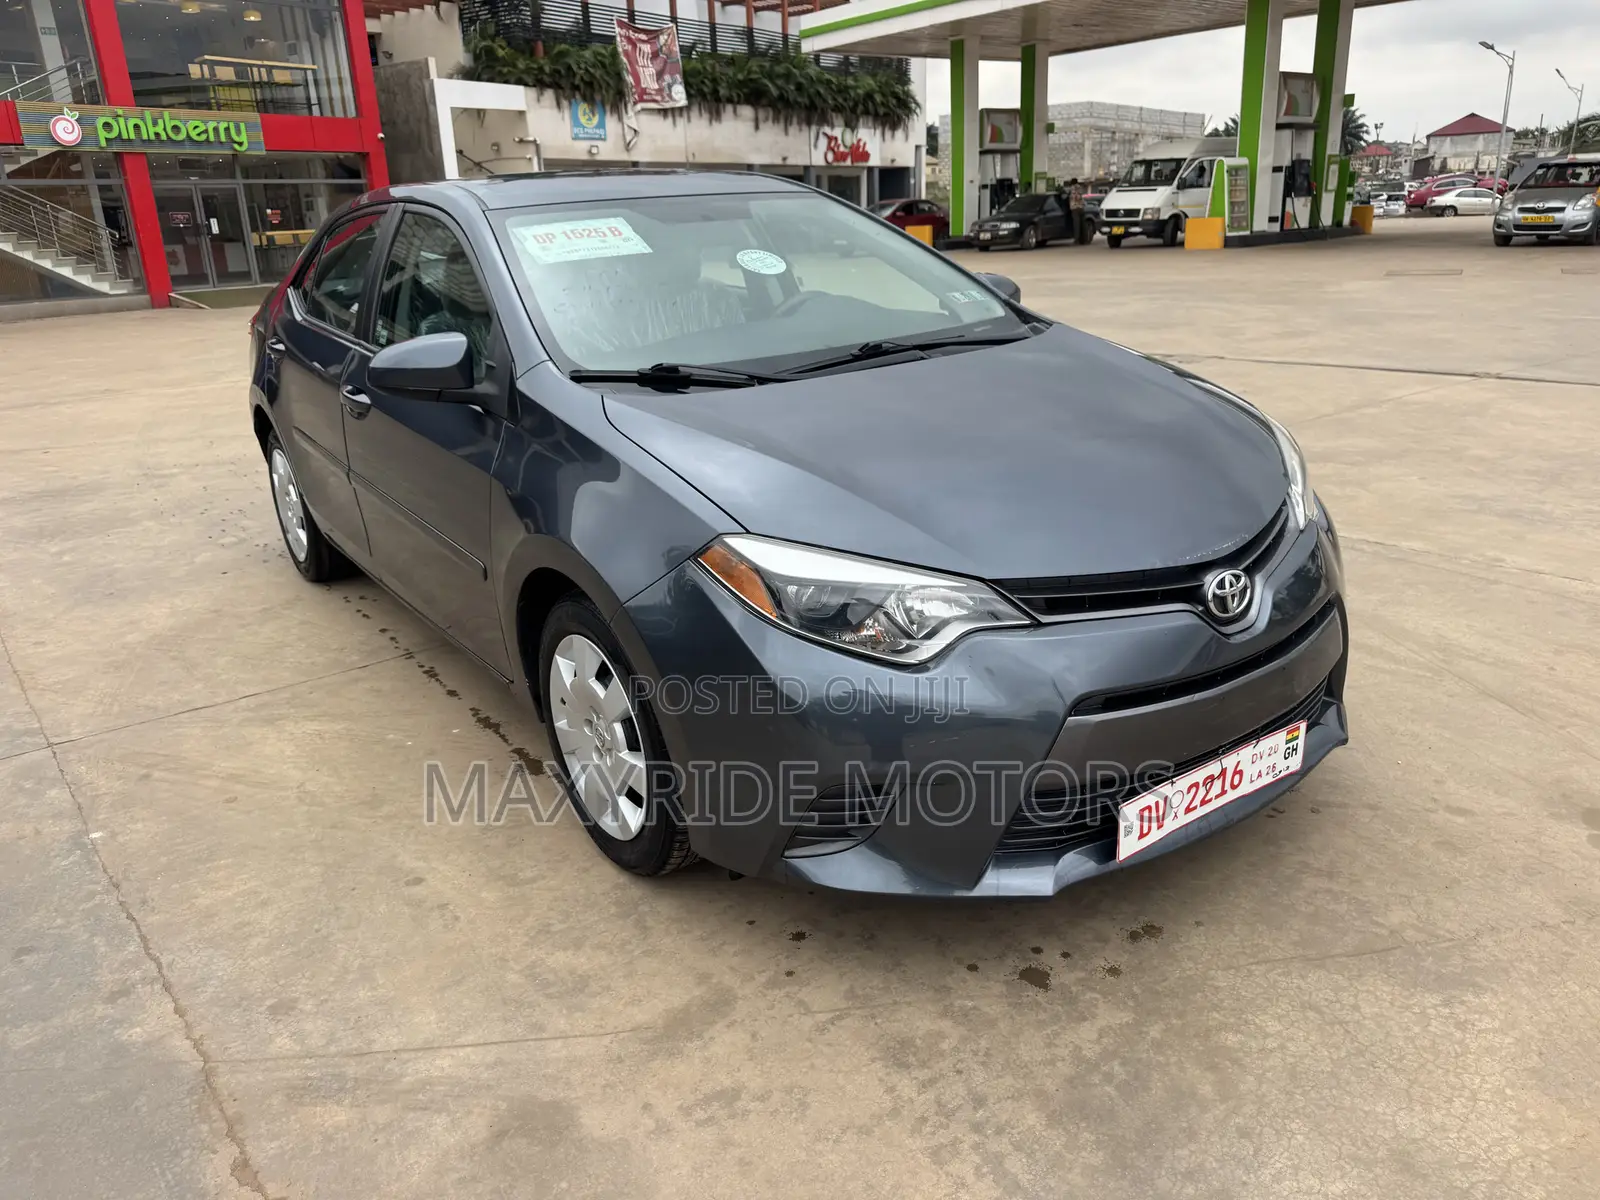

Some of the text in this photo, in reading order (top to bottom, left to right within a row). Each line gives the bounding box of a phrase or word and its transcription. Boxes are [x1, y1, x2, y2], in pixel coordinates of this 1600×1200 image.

[96, 108, 249, 152] pinkberry
[1251, 750, 1265, 765] DV
[1283, 742, 1299, 761] GH
[1249, 771, 1263, 784] LA
[1137, 795, 1169, 841] DV
[1183, 760, 1244, 816] 2216
